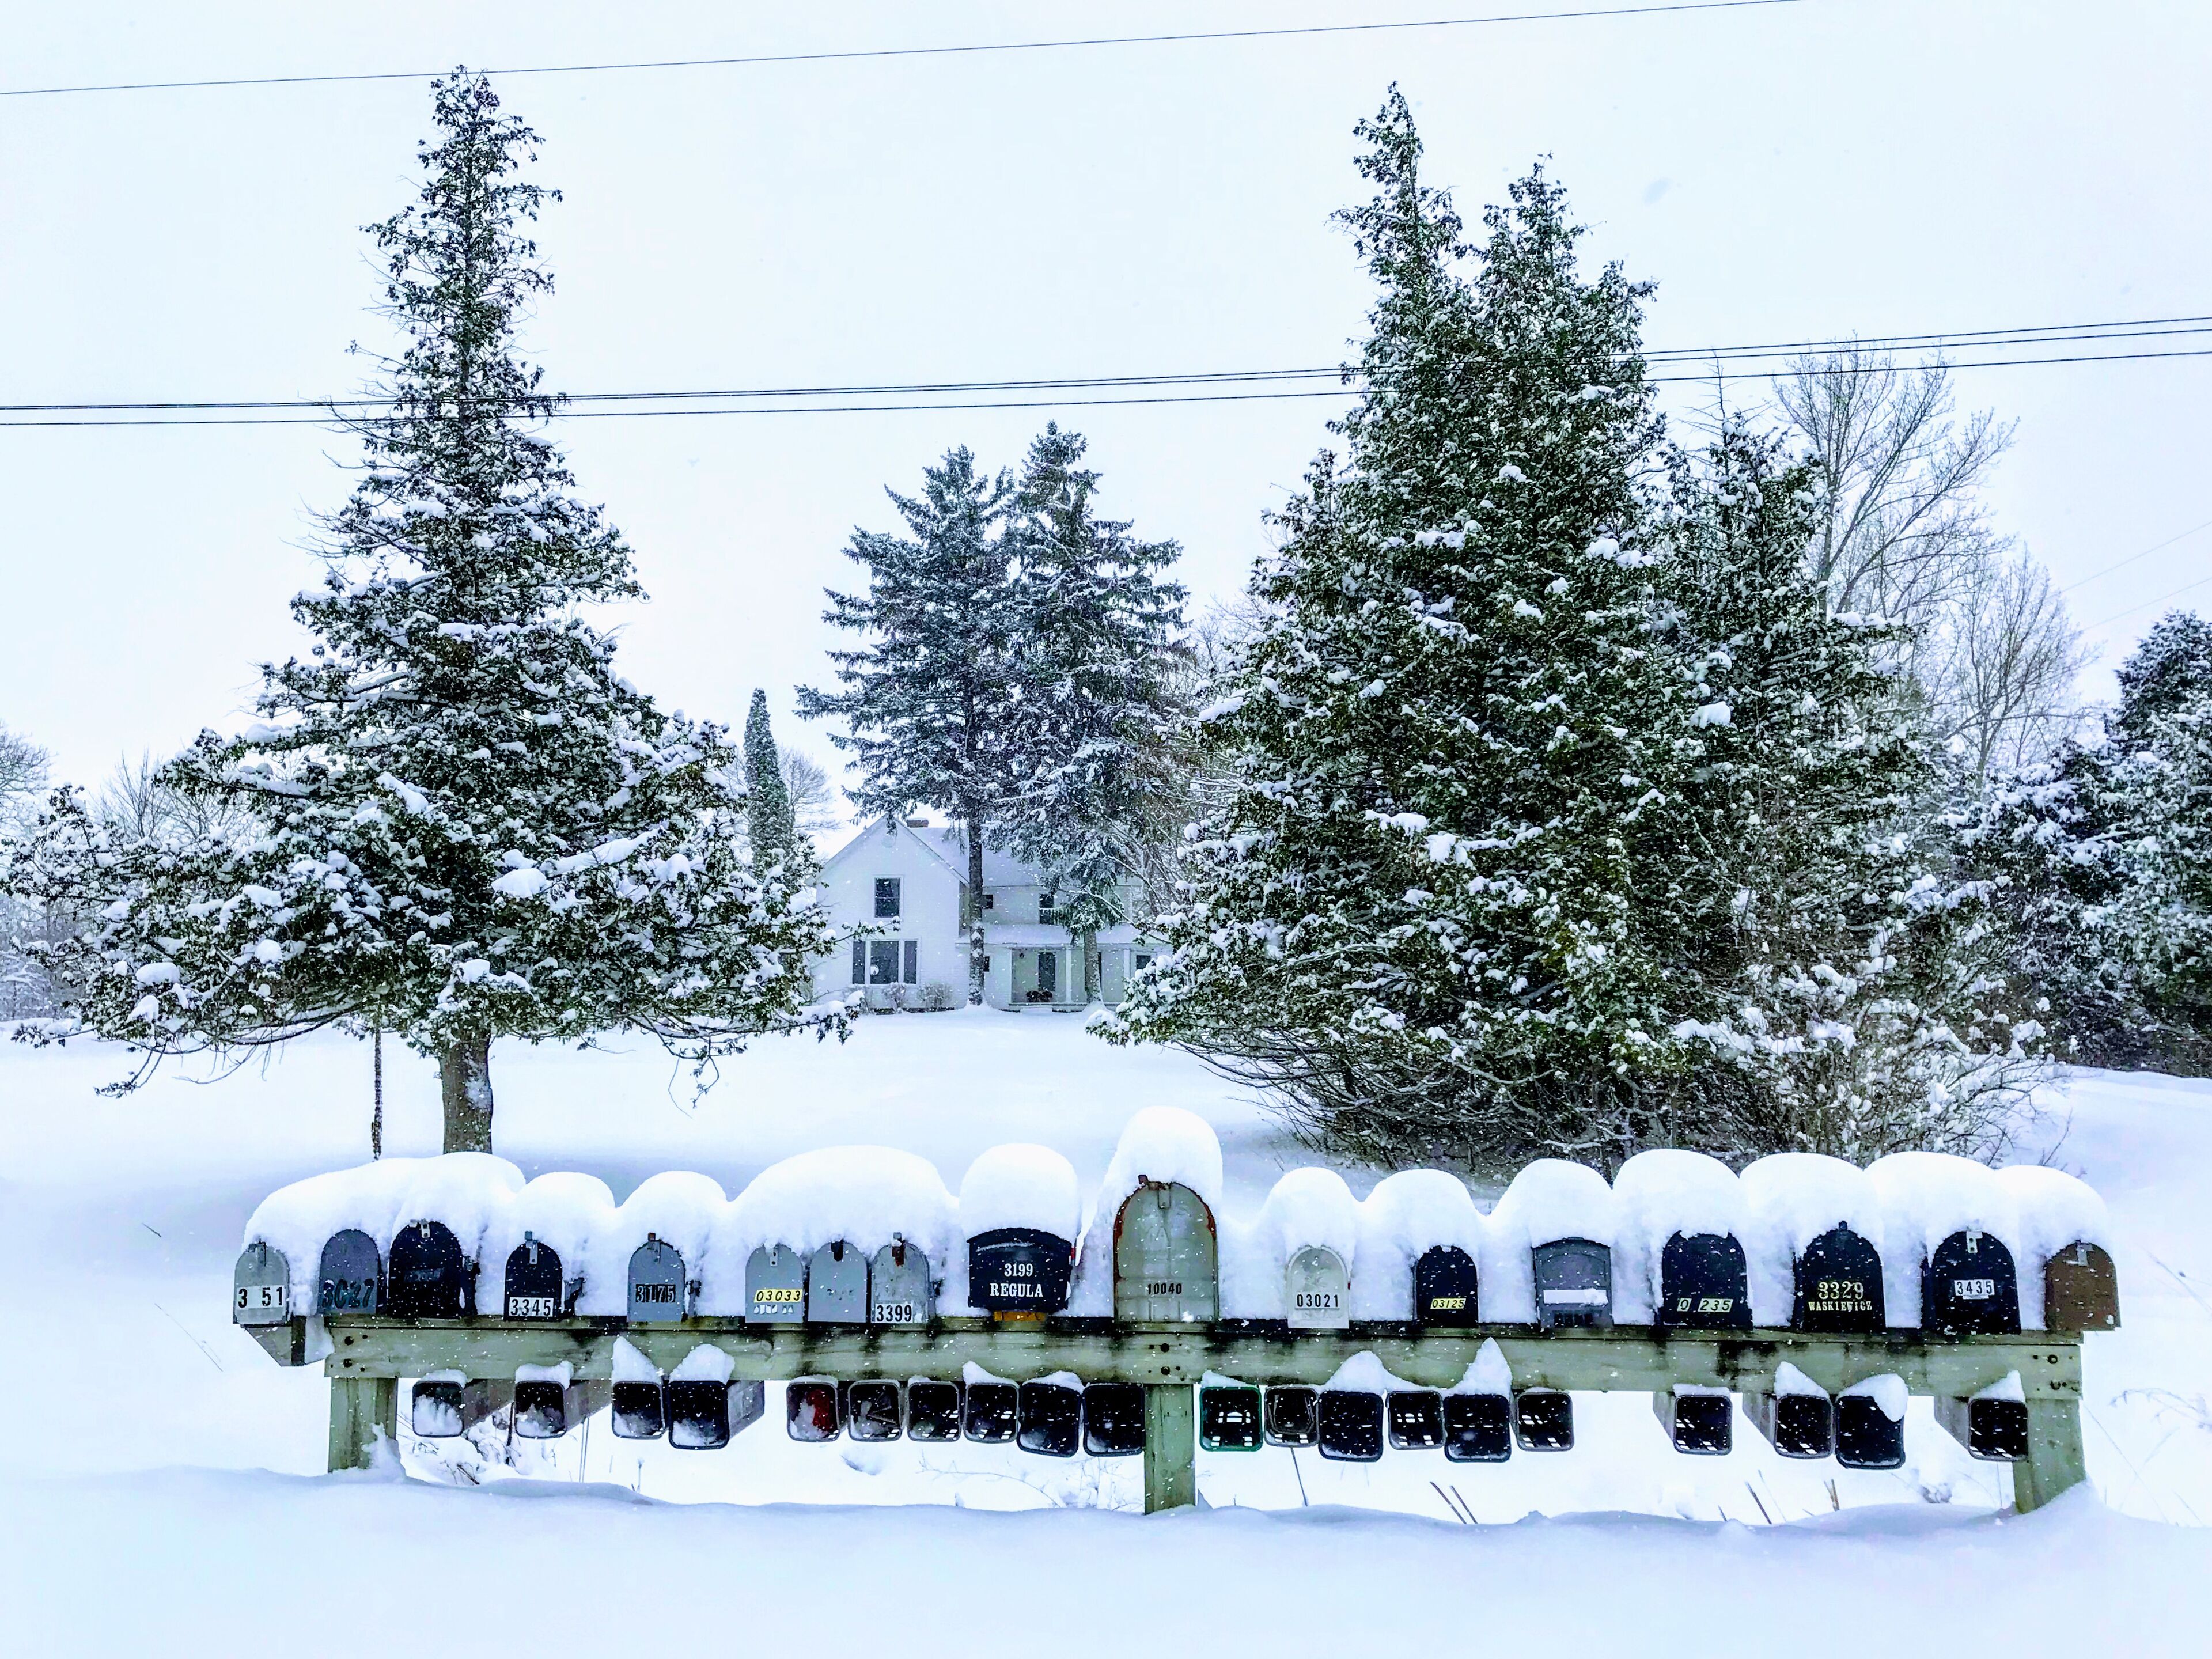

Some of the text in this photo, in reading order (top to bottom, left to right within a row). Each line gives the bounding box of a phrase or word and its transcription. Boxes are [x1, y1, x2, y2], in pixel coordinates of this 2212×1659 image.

[1004, 1263, 1033, 1277] 3199
[637, 1285, 675, 1302] 3175
[990, 1283, 1044, 1297] REGULA
[1148, 1283, 1182, 1294] 10040
[1819, 1281, 1864, 1300] 3329
[1956, 1281, 1993, 1294] 3435
[756, 1290, 801, 1302] 03033
[1297, 1293, 1338, 1308] 03021
[510, 1298, 551, 1316] 3345
[1432, 1300, 1464, 1308] 03125
[1808, 1301, 1872, 1312] WASKIEWICZ
[876, 1305, 912, 1322] 3399
